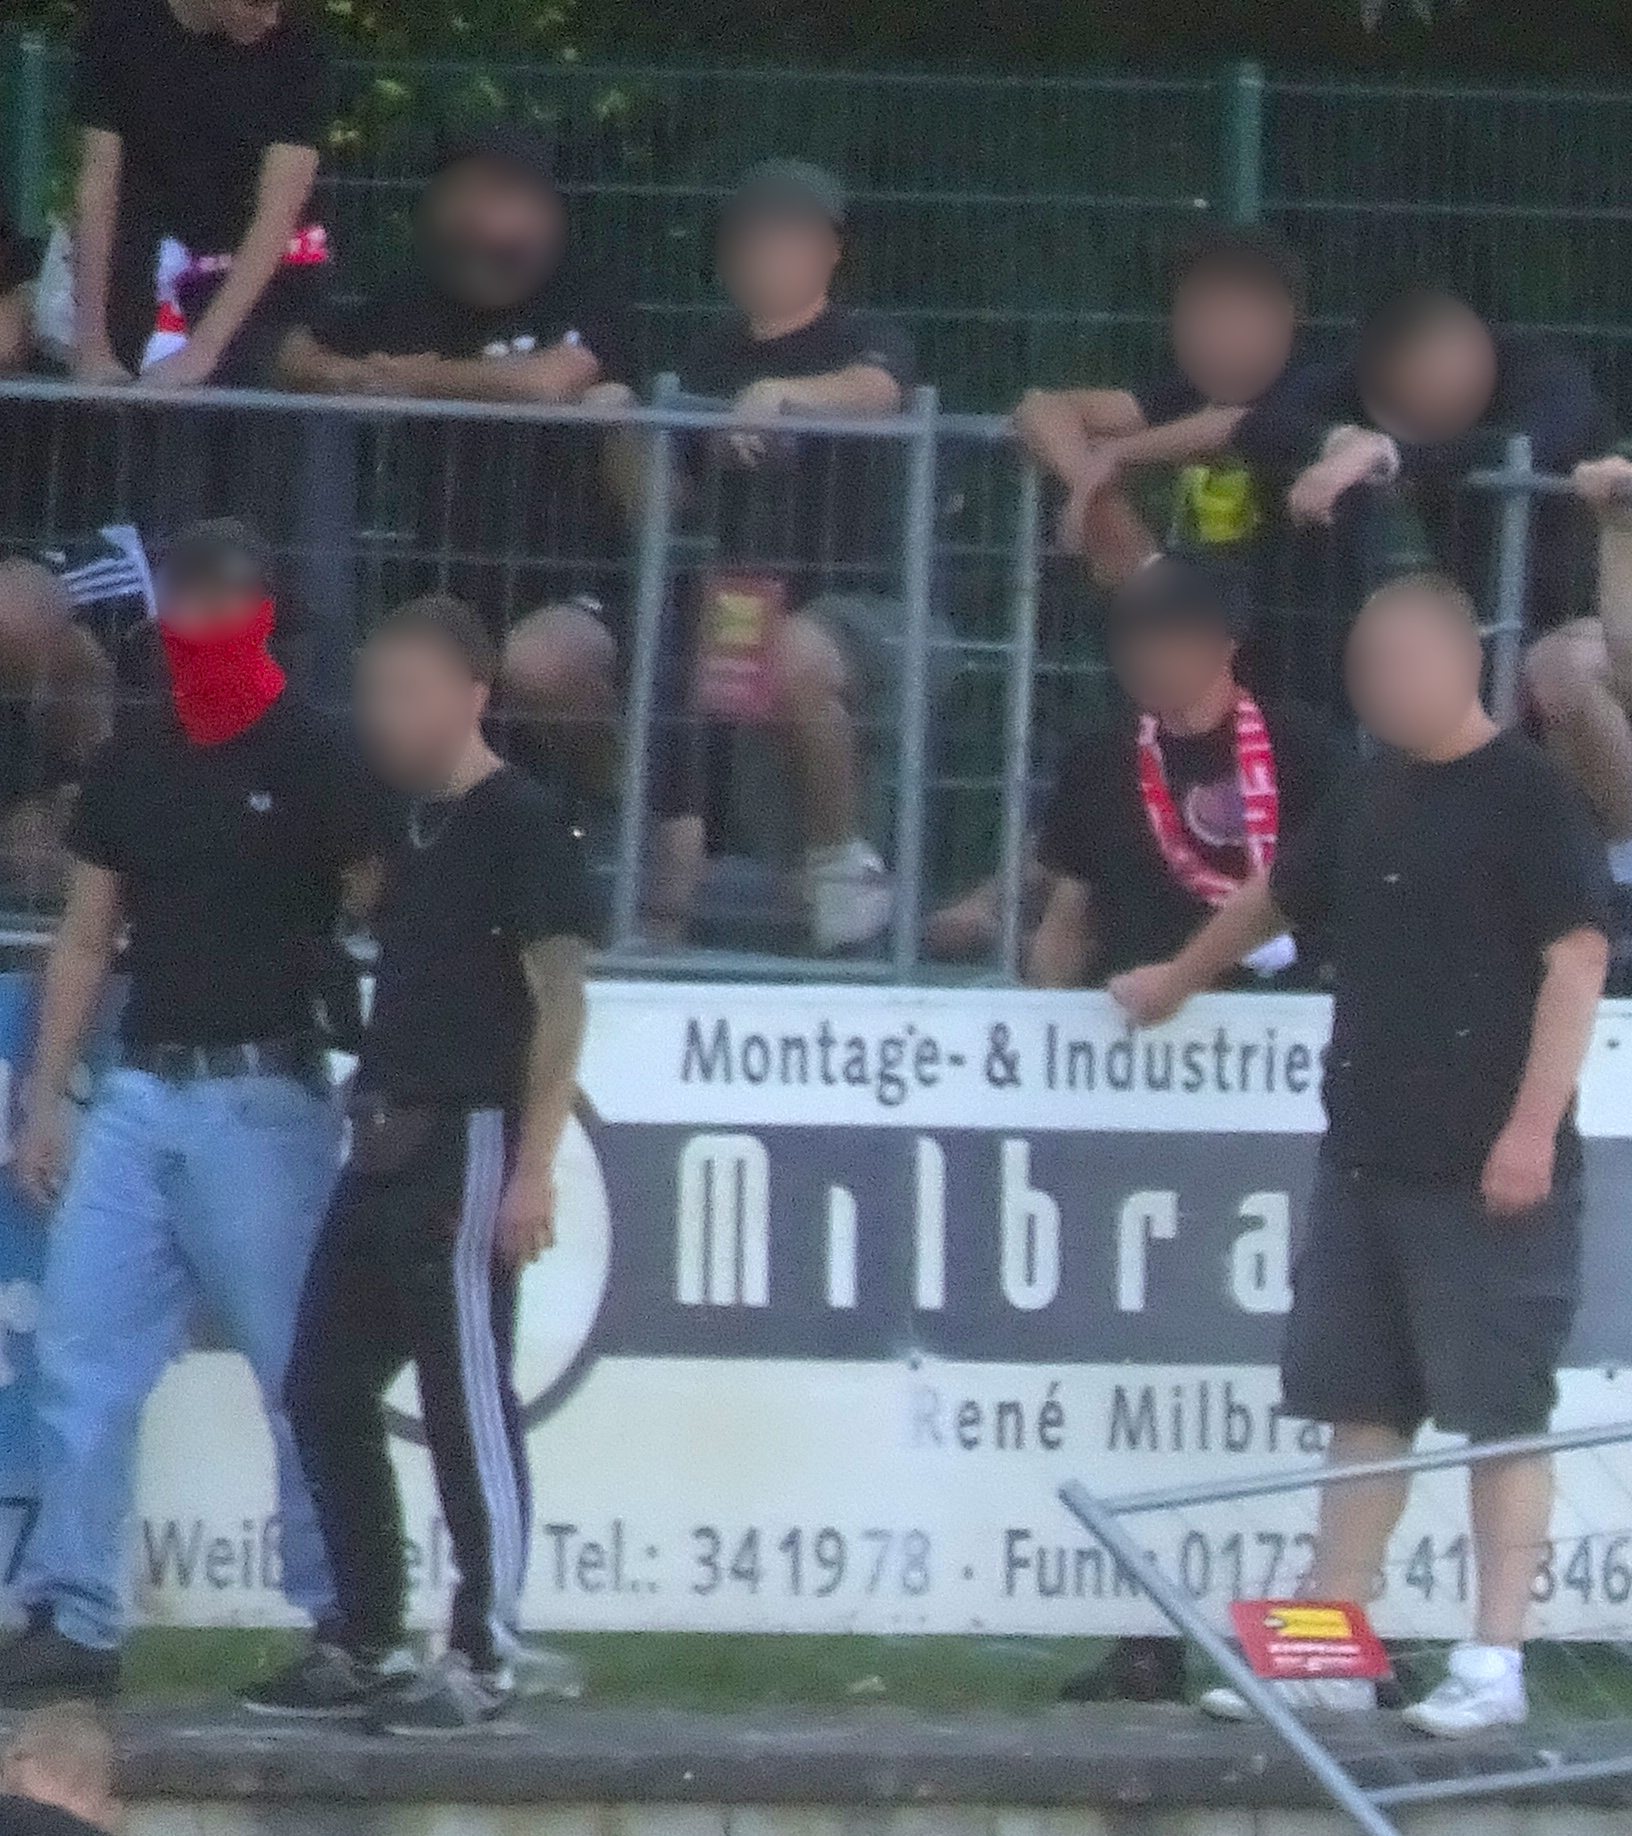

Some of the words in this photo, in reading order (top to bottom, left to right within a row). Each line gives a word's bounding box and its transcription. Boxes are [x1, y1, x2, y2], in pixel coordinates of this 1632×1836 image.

[681, 1018, 966, 1107] Montage-
[984, 1021, 1022, 1090] &
[1045, 1024, 1312, 1094] Industrie
[676, 1132, 1295, 1315] Milbra
[912, 1380, 1066, 1451] René
[1107, 1380, 1328, 1453] Milbra
[690, 1525, 932, 1598] 341978
